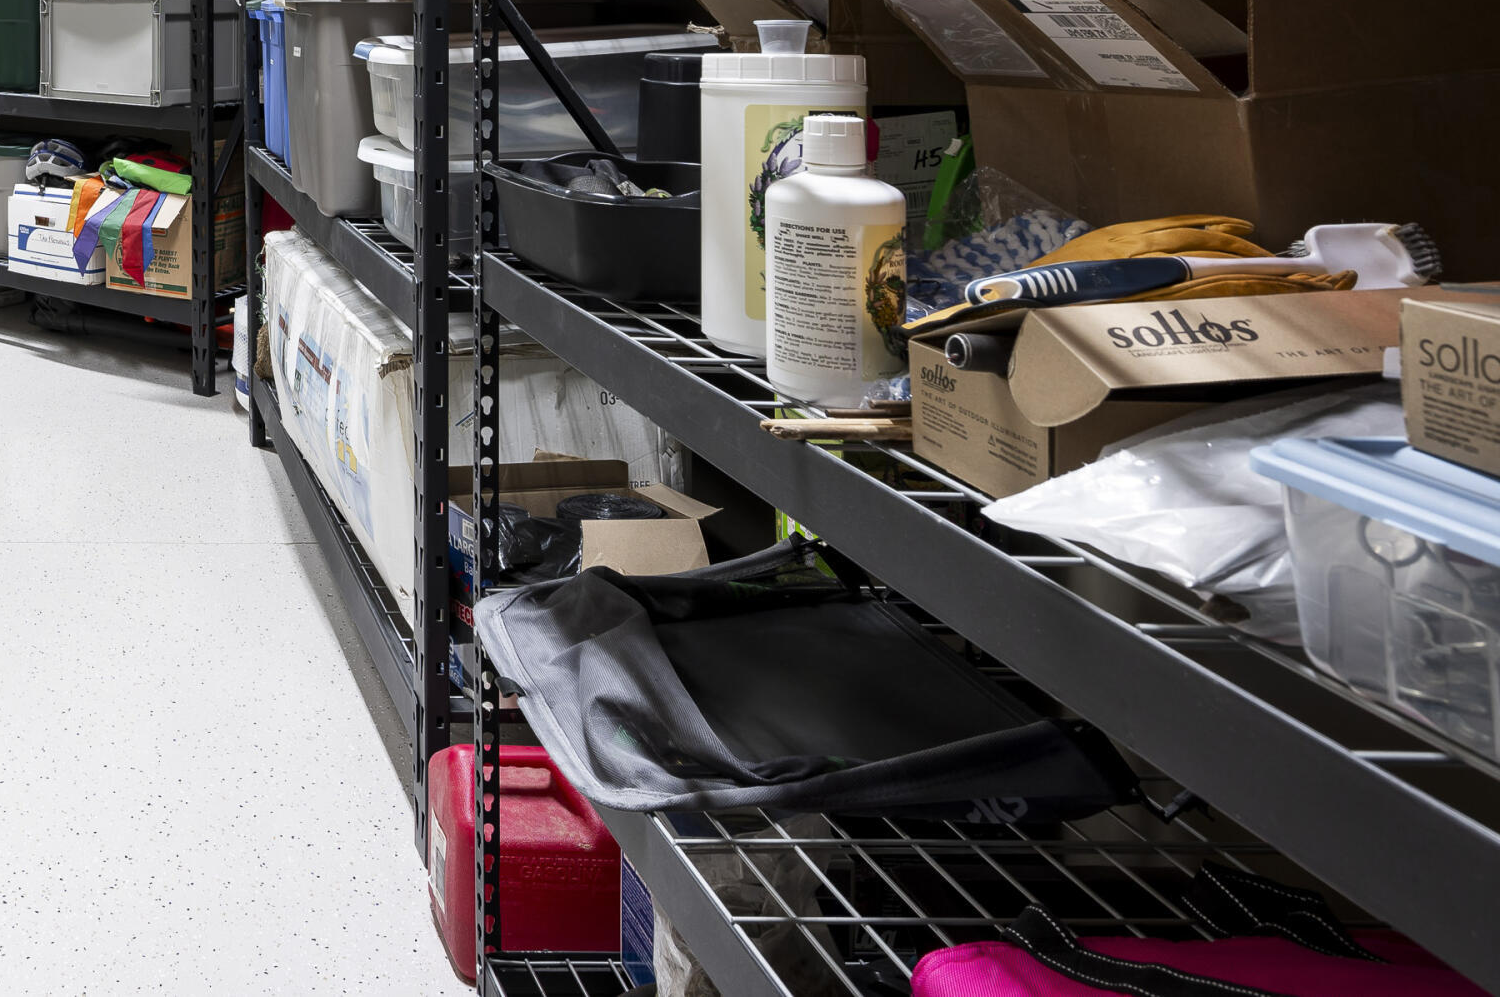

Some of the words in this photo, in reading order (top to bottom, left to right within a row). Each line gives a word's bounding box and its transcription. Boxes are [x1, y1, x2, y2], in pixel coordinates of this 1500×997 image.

[914, 147, 942, 170] H5
[780, 222, 814, 232] DIRECTIONS
[1107, 308, 1259, 348] sollos
[1276, 350, 1308, 358] THE
[1315, 347, 1344, 356] ART
[1350, 346, 1370, 355] OF
[1419, 336, 1500, 384] sollo
[920, 364, 956, 393] sollos
[1420, 378, 1443, 396] THE
[1449, 387, 1473, 403] ART
[453, 534, 475, 559] LARG
[520, 865, 605, 881] GASOLIN
